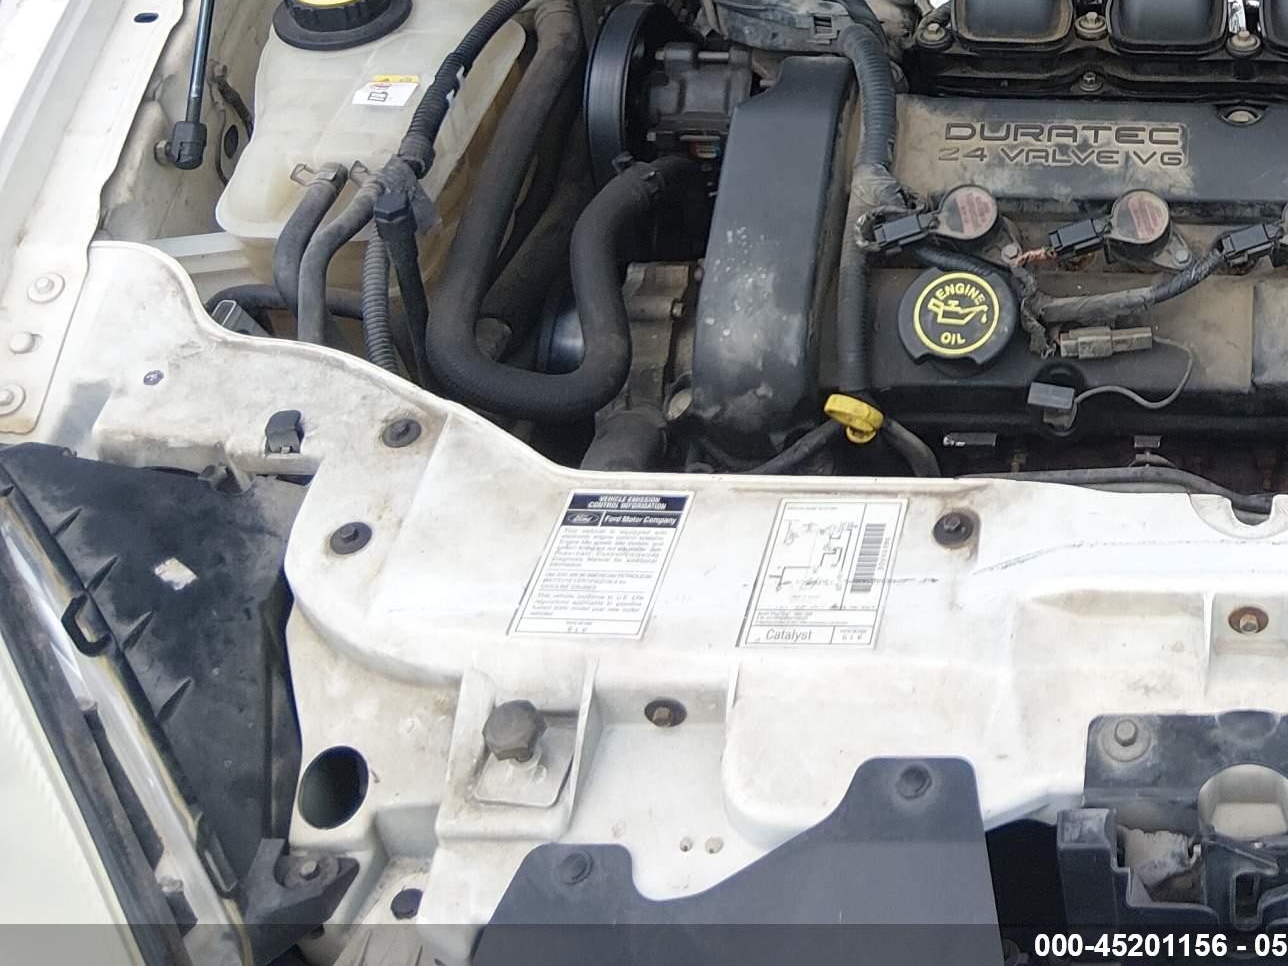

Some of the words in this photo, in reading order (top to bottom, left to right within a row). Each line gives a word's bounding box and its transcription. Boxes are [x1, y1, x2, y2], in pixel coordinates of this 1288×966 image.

[944, 122, 1181, 147] DURATEC
[938, 147, 988, 162] 24
[1000, 147, 1120, 165] VALVE
[1132, 150, 1183, 167] V6
[935, 282, 986, 305] ENGINE
[940, 331, 966, 345] OIL
[604, 515, 621, 524] Ford
[622, 516, 643, 524] Motor
[643, 516, 677, 526] Company
[765, 628, 813, 642] Catalyst
